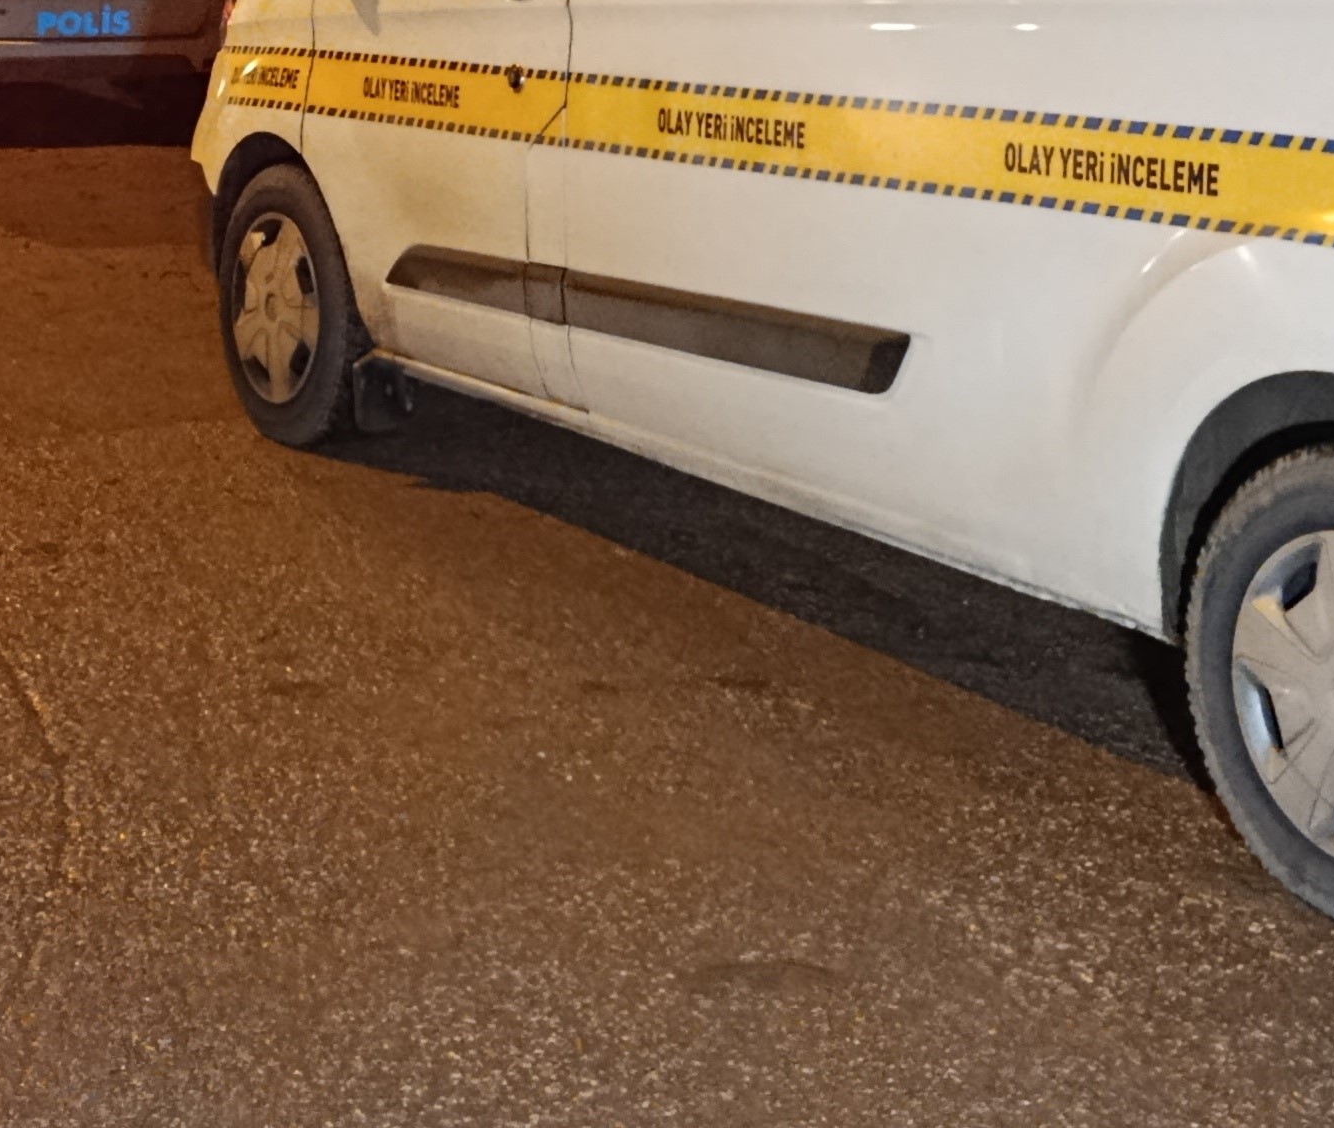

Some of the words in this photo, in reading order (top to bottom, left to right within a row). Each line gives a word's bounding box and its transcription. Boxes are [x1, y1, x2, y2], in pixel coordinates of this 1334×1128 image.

[37, 3, 131, 37] POLİS
[363, 76, 387, 99] OLAY
[657, 108, 693, 135] OLAY
[1004, 142, 1054, 176] OLAY
